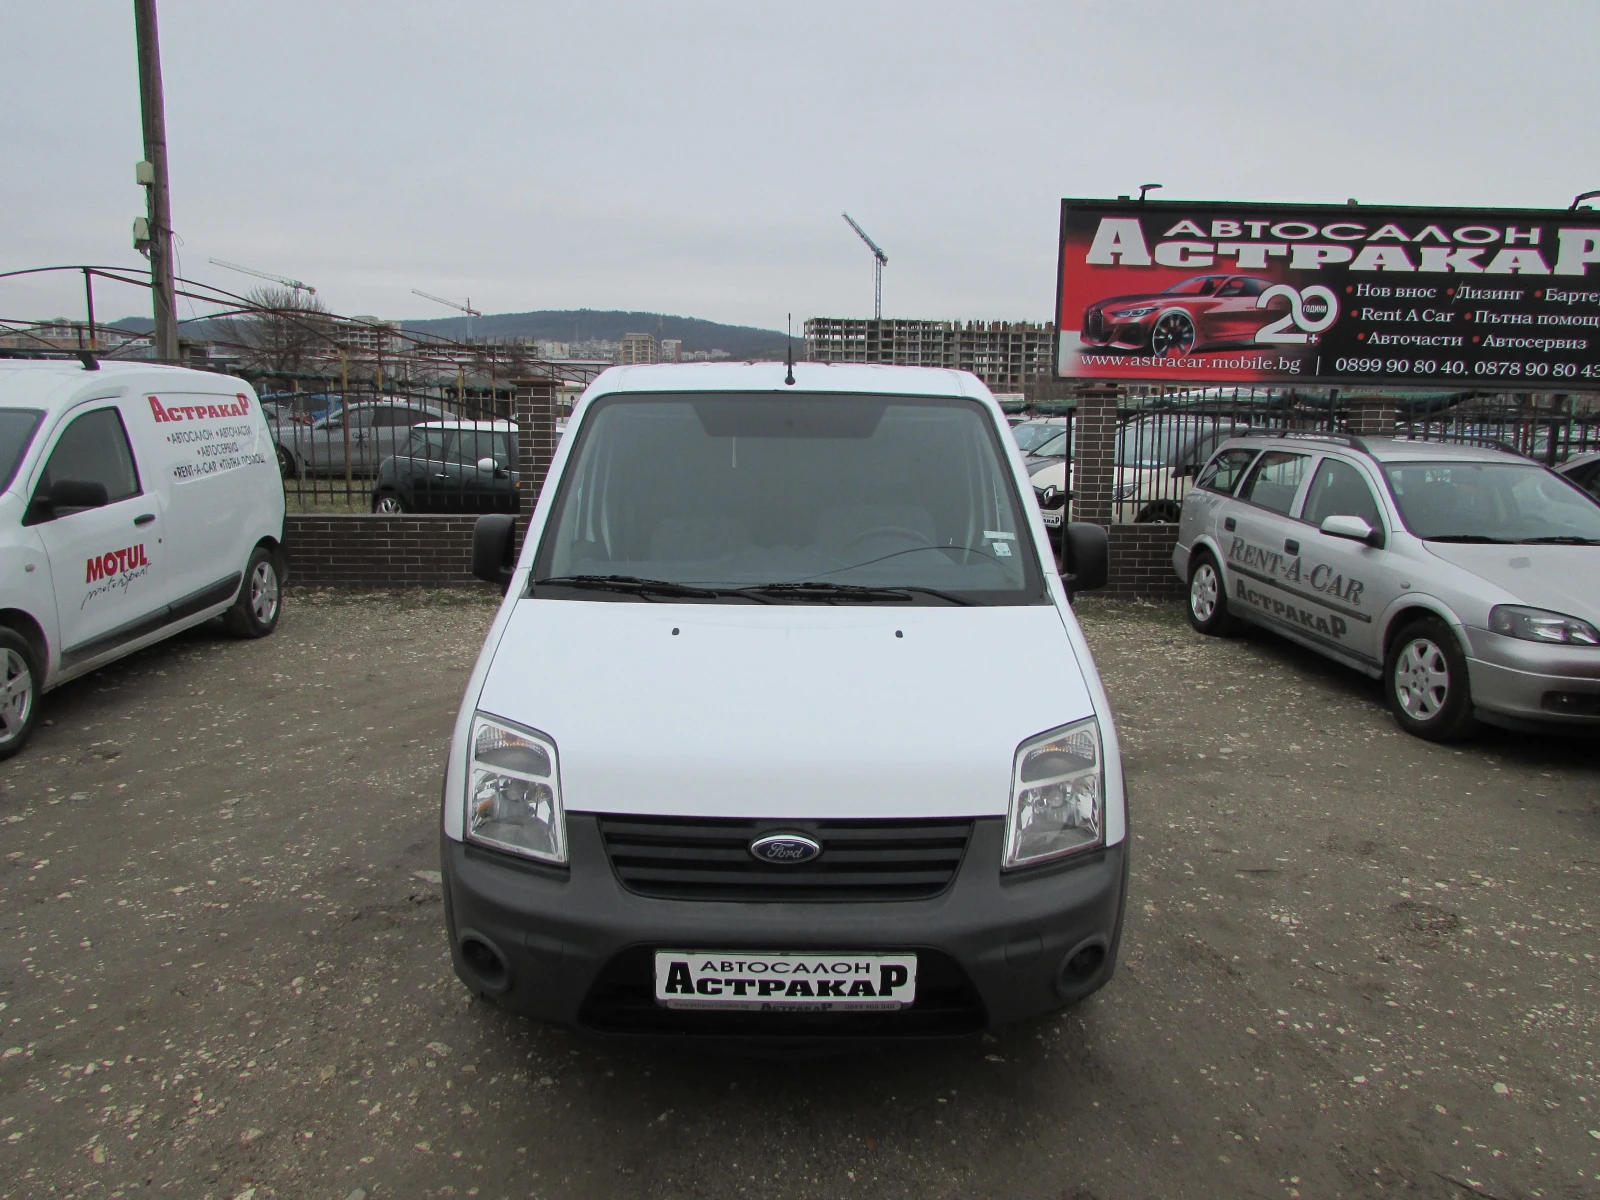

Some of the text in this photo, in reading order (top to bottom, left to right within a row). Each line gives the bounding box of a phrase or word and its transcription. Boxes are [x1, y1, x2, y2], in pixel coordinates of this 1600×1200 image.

[1162, 218, 1541, 245] АВТОСАЛОН
[1355, 283, 1393, 298] Нов
[1395, 286, 1437, 299] внос
[1456, 286, 1525, 301] Лизинг
[1302, 304, 1327, 314] ГОДИНИ
[1360, 307, 1456, 324] Rent A Car
[1474, 310, 1600, 328] Пътна помощ
[1366, 332, 1588, 352] Авточасти Автосервиз
[1080, 353, 1301, 374] www.astracar.mobile.bg
[1335, 357, 1382, 373] 0899
[1385, 358, 1410, 374] 90
[1412, 359, 1437, 374] 80
[1440, 360, 1469, 376] 40,
[1474, 361, 1521, 376] 0878
[1524, 362, 1549, 377] 90
[1551, 363, 1577, 378] 80
[171, 425, 253, 444] АВТОСАЛОН АВТОЧАСТИ
[201, 442, 239, 457] АВТОСЕРВИЗ
[177, 461, 218, 478] RENT-A-CAR
[86, 543, 148, 584] MOTUL
[1227, 536, 1365, 606] RENT-A-CAR
[766, 842, 804, 859] Ford
[699, 960, 871, 974] АВТОСАЛОН
